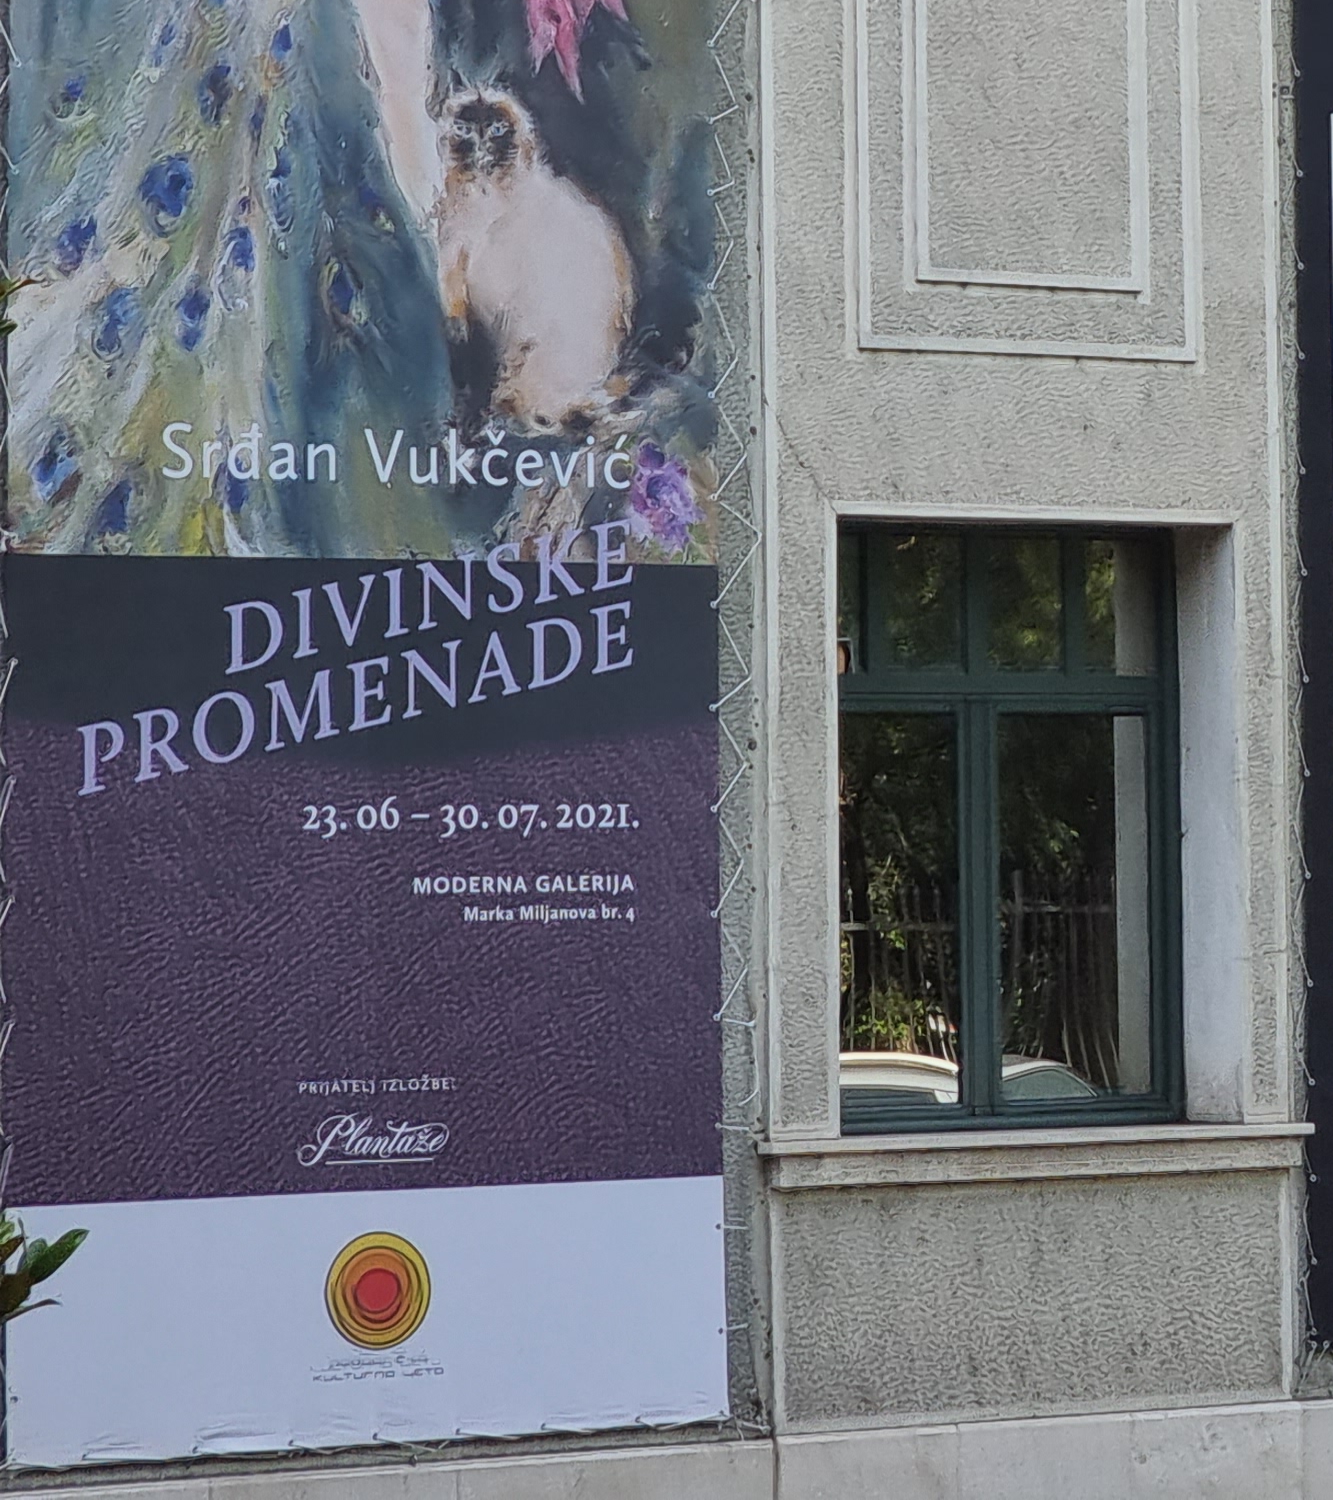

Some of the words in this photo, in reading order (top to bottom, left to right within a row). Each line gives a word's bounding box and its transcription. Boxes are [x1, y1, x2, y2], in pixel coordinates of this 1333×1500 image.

[161, 421, 338, 481] Srđan
[363, 427, 631, 490] Vukčević
[223, 518, 636, 675] DIVINSKE
[77, 600, 636, 796] PROMENADE
[555, 803, 640, 830] 2021.
[413, 876, 528, 894] MODERNA
[535, 875, 635, 896] GALERIJA
[463, 906, 514, 922] Marka
[519, 904, 596, 924] Miljanova
[601, 904, 622, 920] br.
[625, 907, 635, 922] 4
[298, 1080, 376, 1096] PRIJATELJ
[297, 1112, 450, 1166] Plantaže
